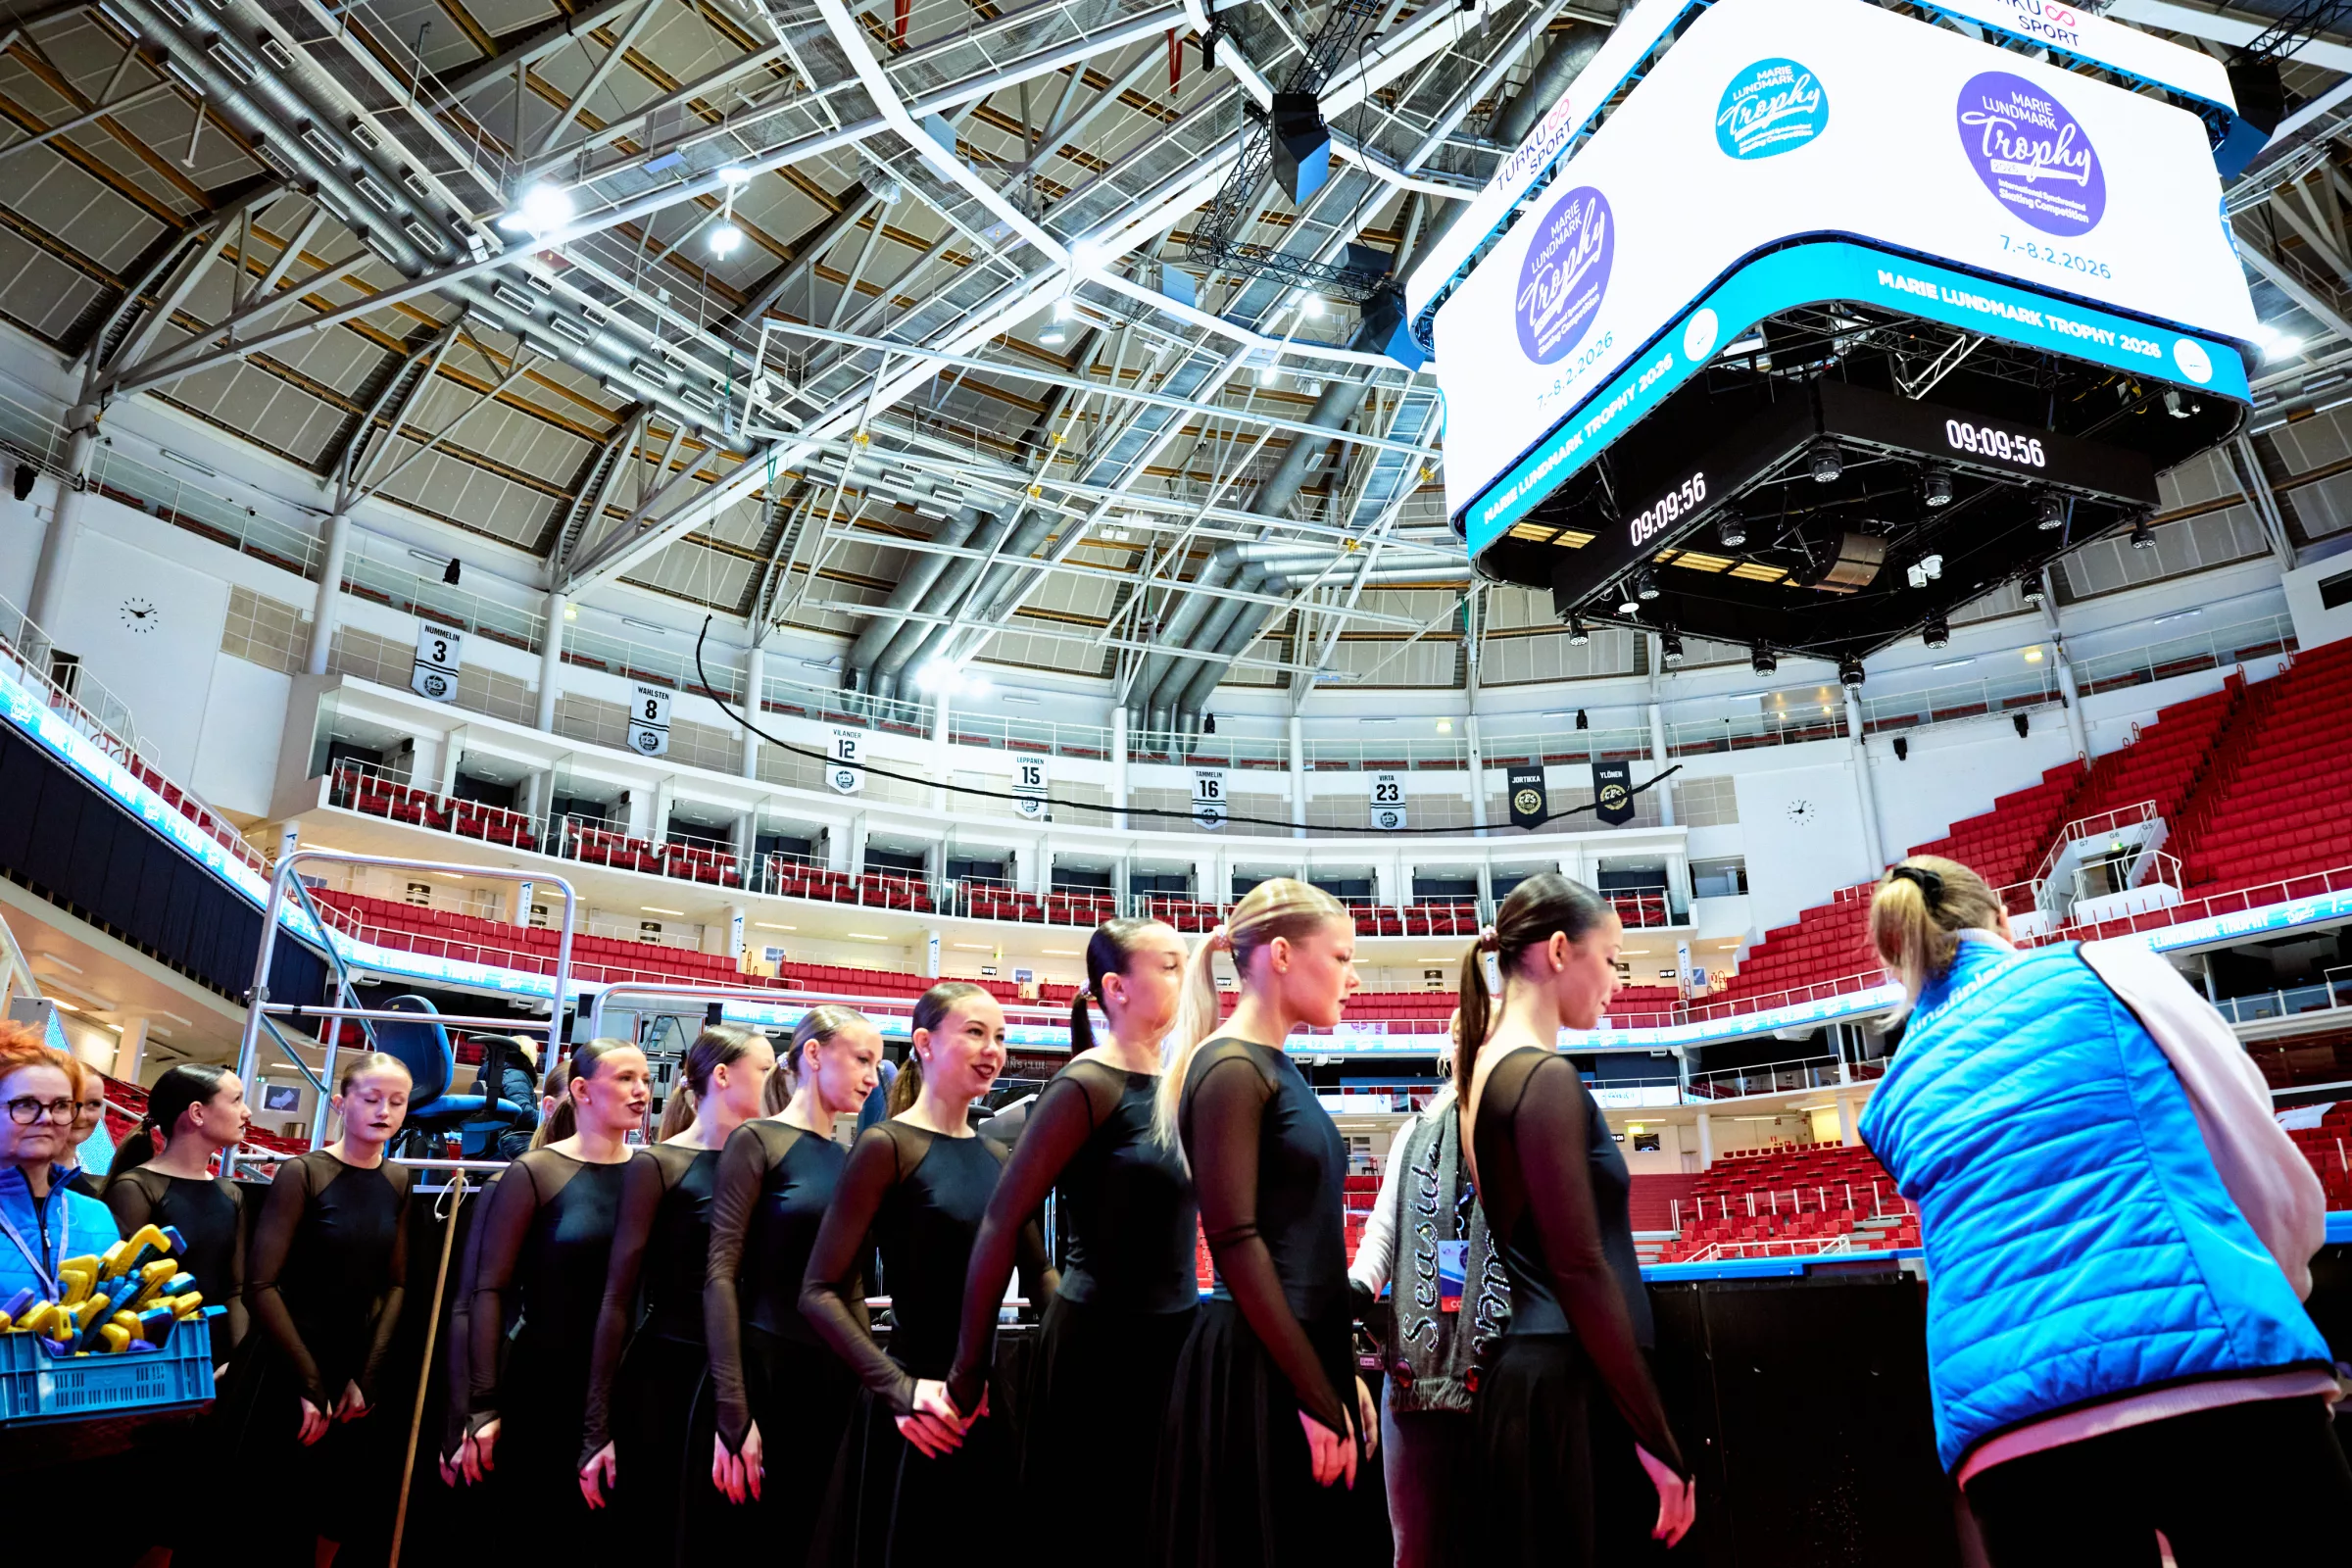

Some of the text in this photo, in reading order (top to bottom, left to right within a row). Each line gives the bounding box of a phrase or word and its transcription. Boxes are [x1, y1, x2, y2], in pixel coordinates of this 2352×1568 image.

[2019, 16, 2079, 46] SPORT
[1756, 65, 1792, 80] MARIE
[1733, 74, 1795, 101] LUNDMARK
[1717, 74, 1820, 136] Trophy
[1982, 95, 2058, 131] LUNDMARK
[2011, 91, 2053, 117] MARIE
[1496, 124, 1545, 190] TURKU
[1530, 116, 1572, 174] SPORT
[1961, 112, 2091, 186] Trophy
[1550, 199, 1580, 237] MARIE
[2034, 198, 2089, 223] Competition
[1531, 212, 1583, 274] LUNDMARK
[2000, 234, 2112, 279] 7.-8.2.2026
[1518, 197, 1605, 327] Trophy
[1877, 270, 2162, 359] MARIE LUNDMARK TROPHY 2026
[1484, 353, 1673, 524] MARIE LUNDMARK TROPHY 2026
[1945, 419, 2046, 468] 09:09:56
[1630, 471, 1706, 547] 09:09:56
[424, 624, 460, 642] NUMMELIN
[432, 640, 447, 662] 3
[637, 685, 669, 701] WAHLSTEN
[645, 699, 658, 719] 8
[833, 728, 861, 739] VILANDER
[838, 739, 856, 760] 12
[1022, 766, 1040, 784] 15
[1512, 775, 1542, 784] JORTIKKA
[1599, 770, 1623, 779] YLÖNEN
[1200, 780, 1219, 798] 16
[1376, 784, 1398, 802] 23
[2223, 911, 2269, 934] TROPHY
[1402, 1141, 1442, 1353] Seaside
